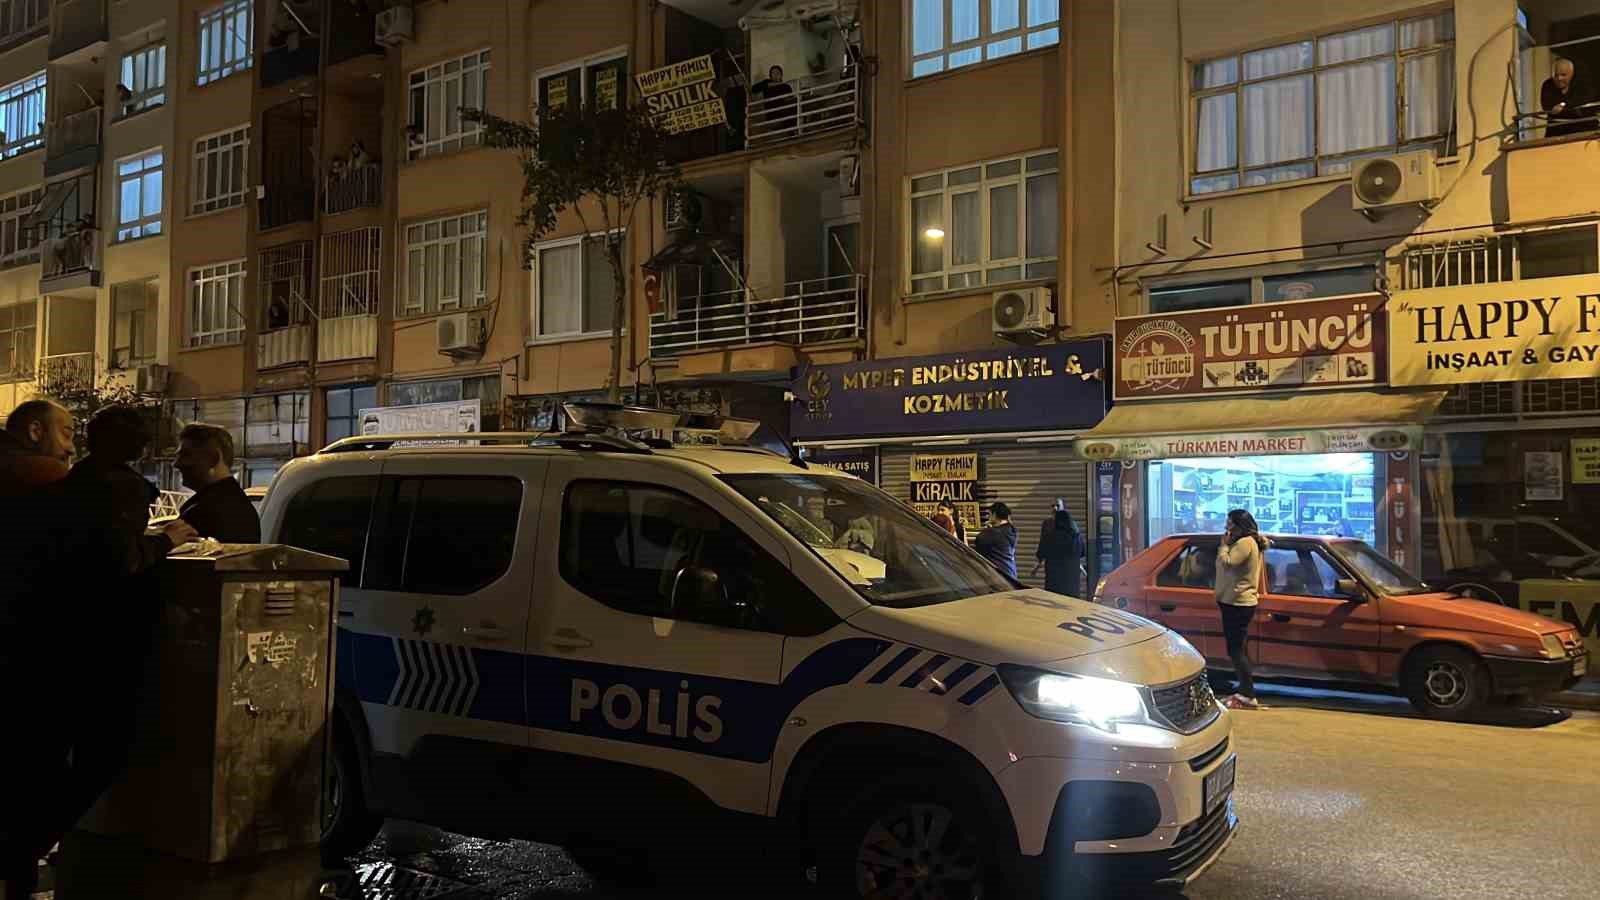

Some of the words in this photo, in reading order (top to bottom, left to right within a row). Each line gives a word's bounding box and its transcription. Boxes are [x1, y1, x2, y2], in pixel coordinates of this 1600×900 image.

[640, 70, 671, 87] HAPPY
[674, 58, 710, 76] FAMILY
[646, 81, 719, 114] SATILIK
[1200, 304, 1372, 357] TÜTÜNCÜ
[1415, 297, 1561, 343] HAPPY
[1576, 293, 1600, 333] F
[911, 355, 1053, 386] ENDÜSTRİYEL
[1065, 354, 1082, 375] &
[1427, 351, 1512, 372] İNŞAAT
[1522, 349, 1538, 364] &
[904, 389, 1009, 414] KOZMETİK
[1167, 440, 1238, 454] TÜRKMEN
[1242, 438, 1306, 451] MARKET
[844, 460, 870, 472] SATIŞ
[915, 458, 942, 471] HAPPY
[945, 456, 974, 470] FAMILY
[916, 482, 974, 501] KİRALIK
[570, 678, 722, 744] POLİS
